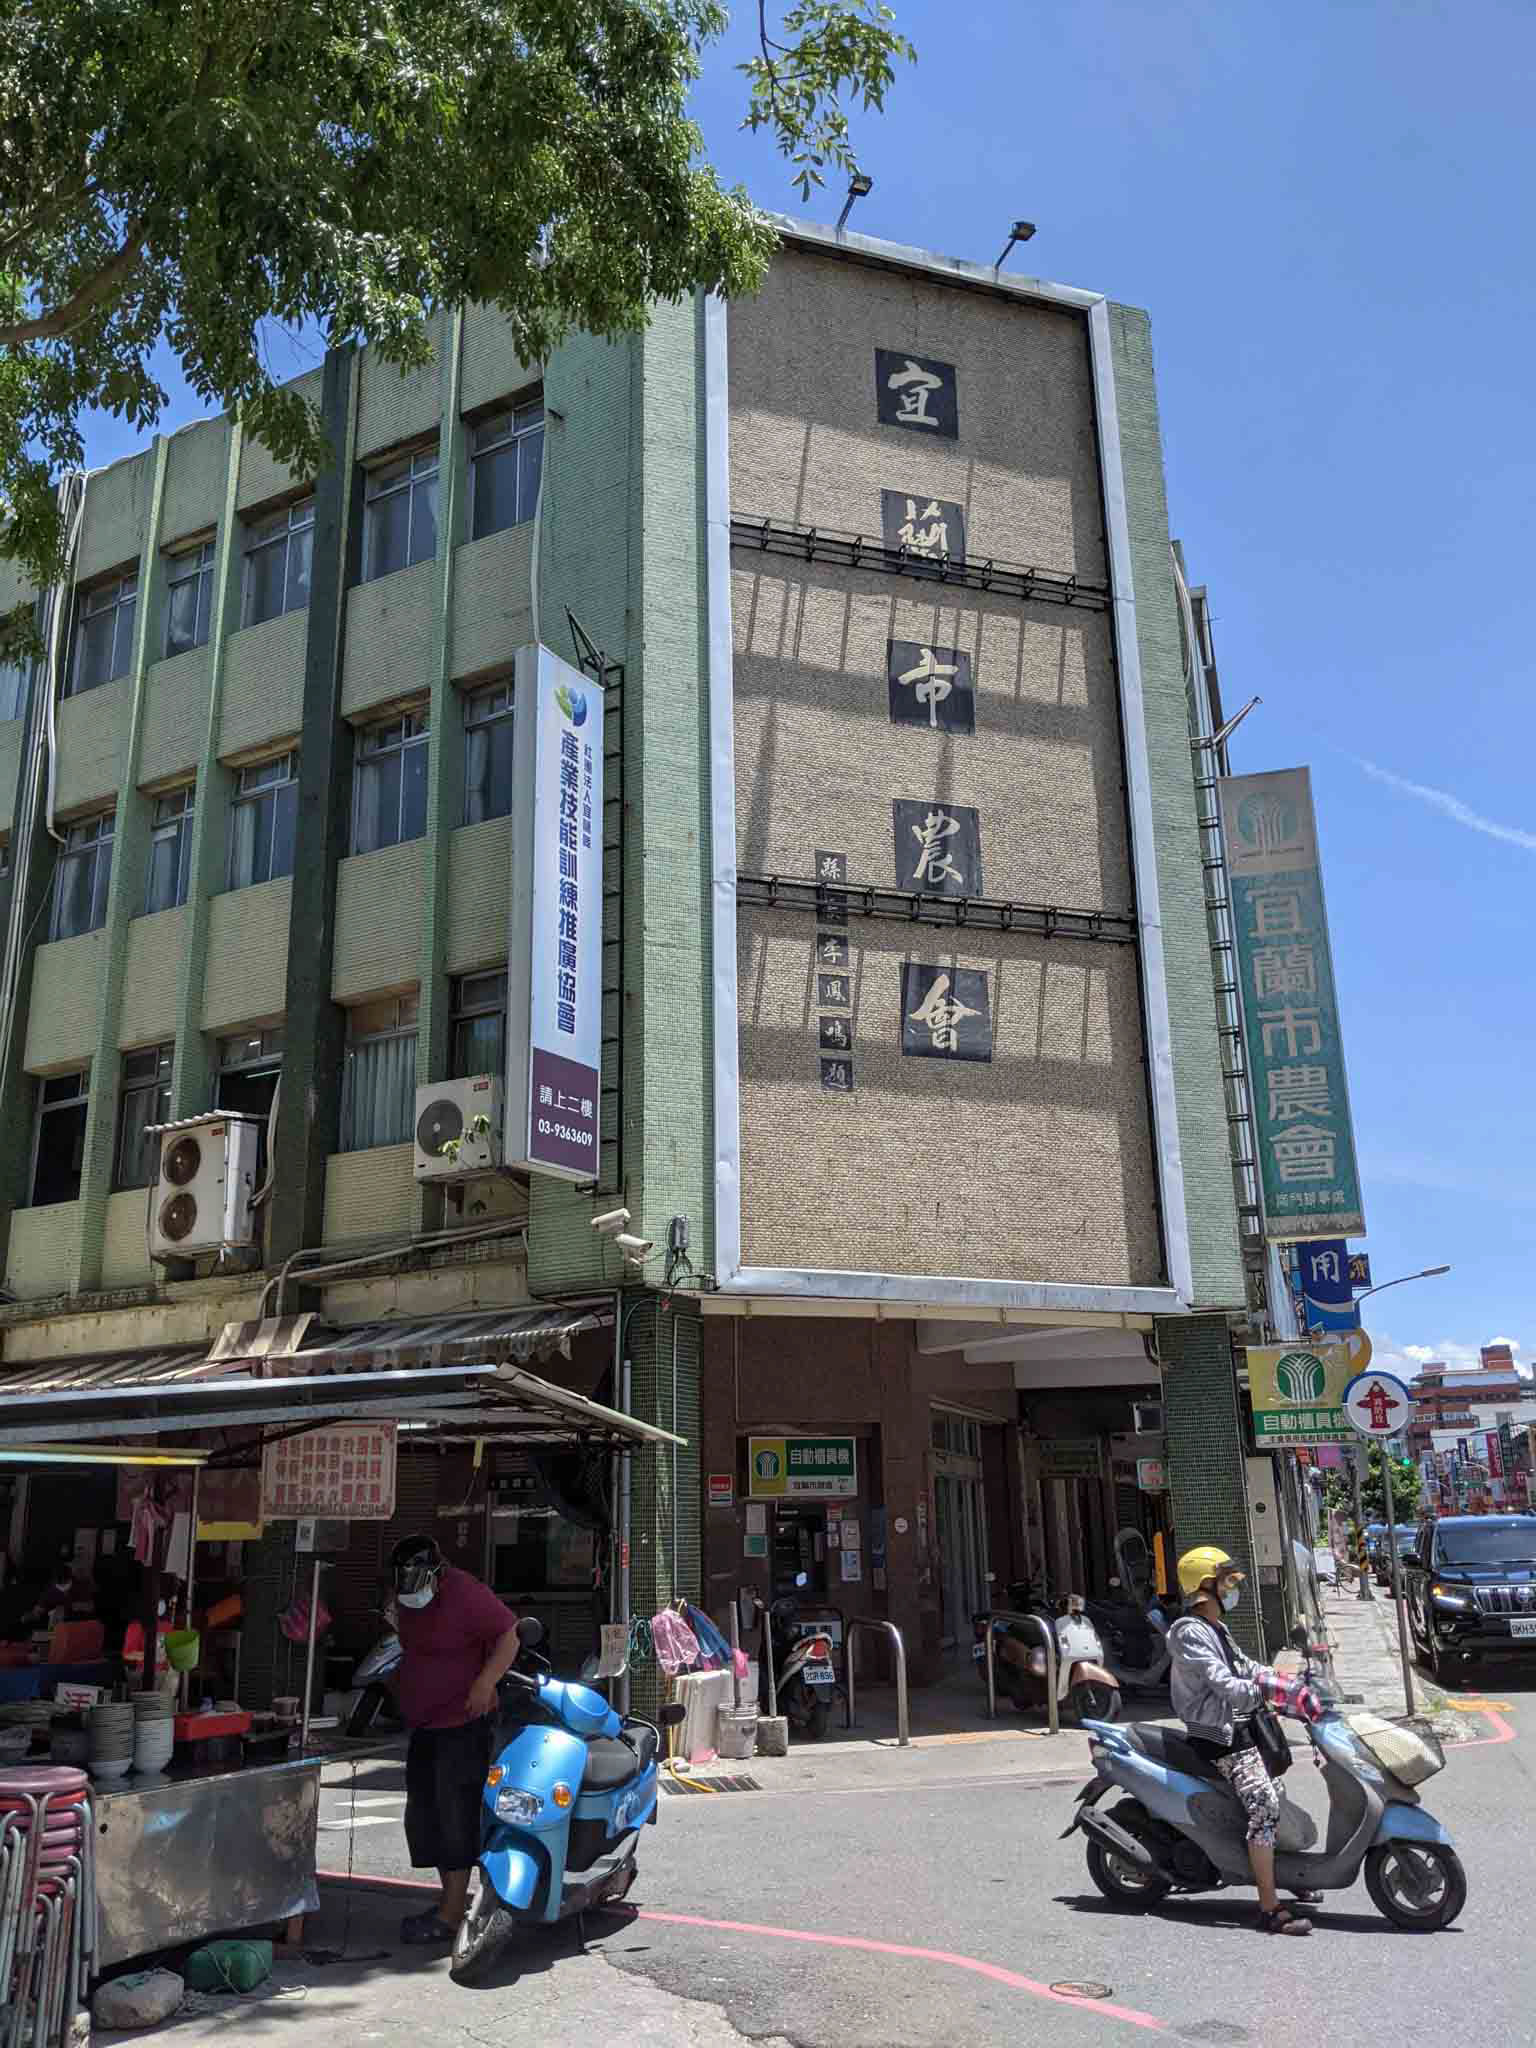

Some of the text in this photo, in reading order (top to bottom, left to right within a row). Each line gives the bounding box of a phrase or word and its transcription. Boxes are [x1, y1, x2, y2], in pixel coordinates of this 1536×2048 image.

[888, 360, 982, 1053] 宜蘭市農會
[1247, 882, 1336, 1182] 宜蘭市農會
[539, 1085, 593, 1119] 請上二樓
[538, 1119, 592, 1146] 03-9363609
[790, 1447, 850, 1465] 自動櫃員機
